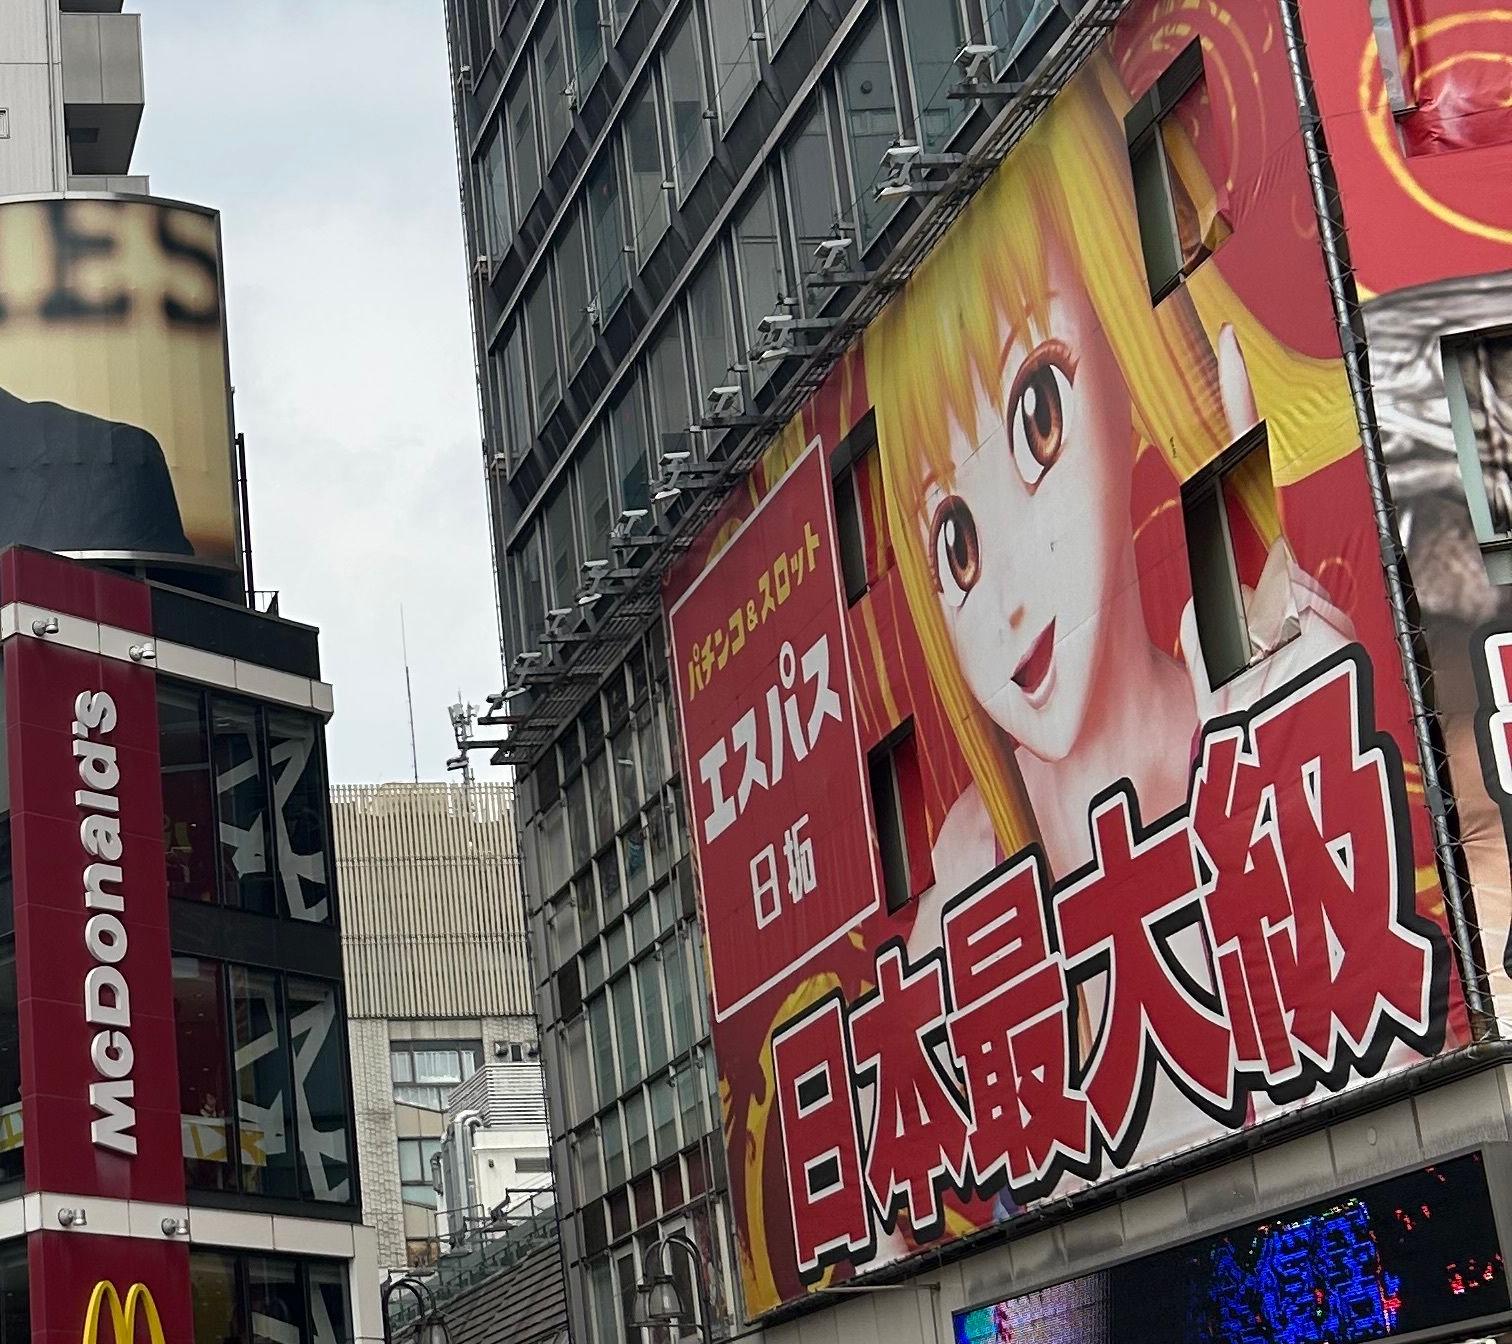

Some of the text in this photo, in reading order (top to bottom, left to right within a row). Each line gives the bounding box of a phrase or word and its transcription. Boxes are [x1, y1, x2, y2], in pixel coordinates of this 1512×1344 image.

[699, 636, 844, 845] エスパス
[750, 811, 819, 931] 日拓
[74, 689, 138, 1156] McDonald's
[775, 654, 1438, 1276] 日本最大級
